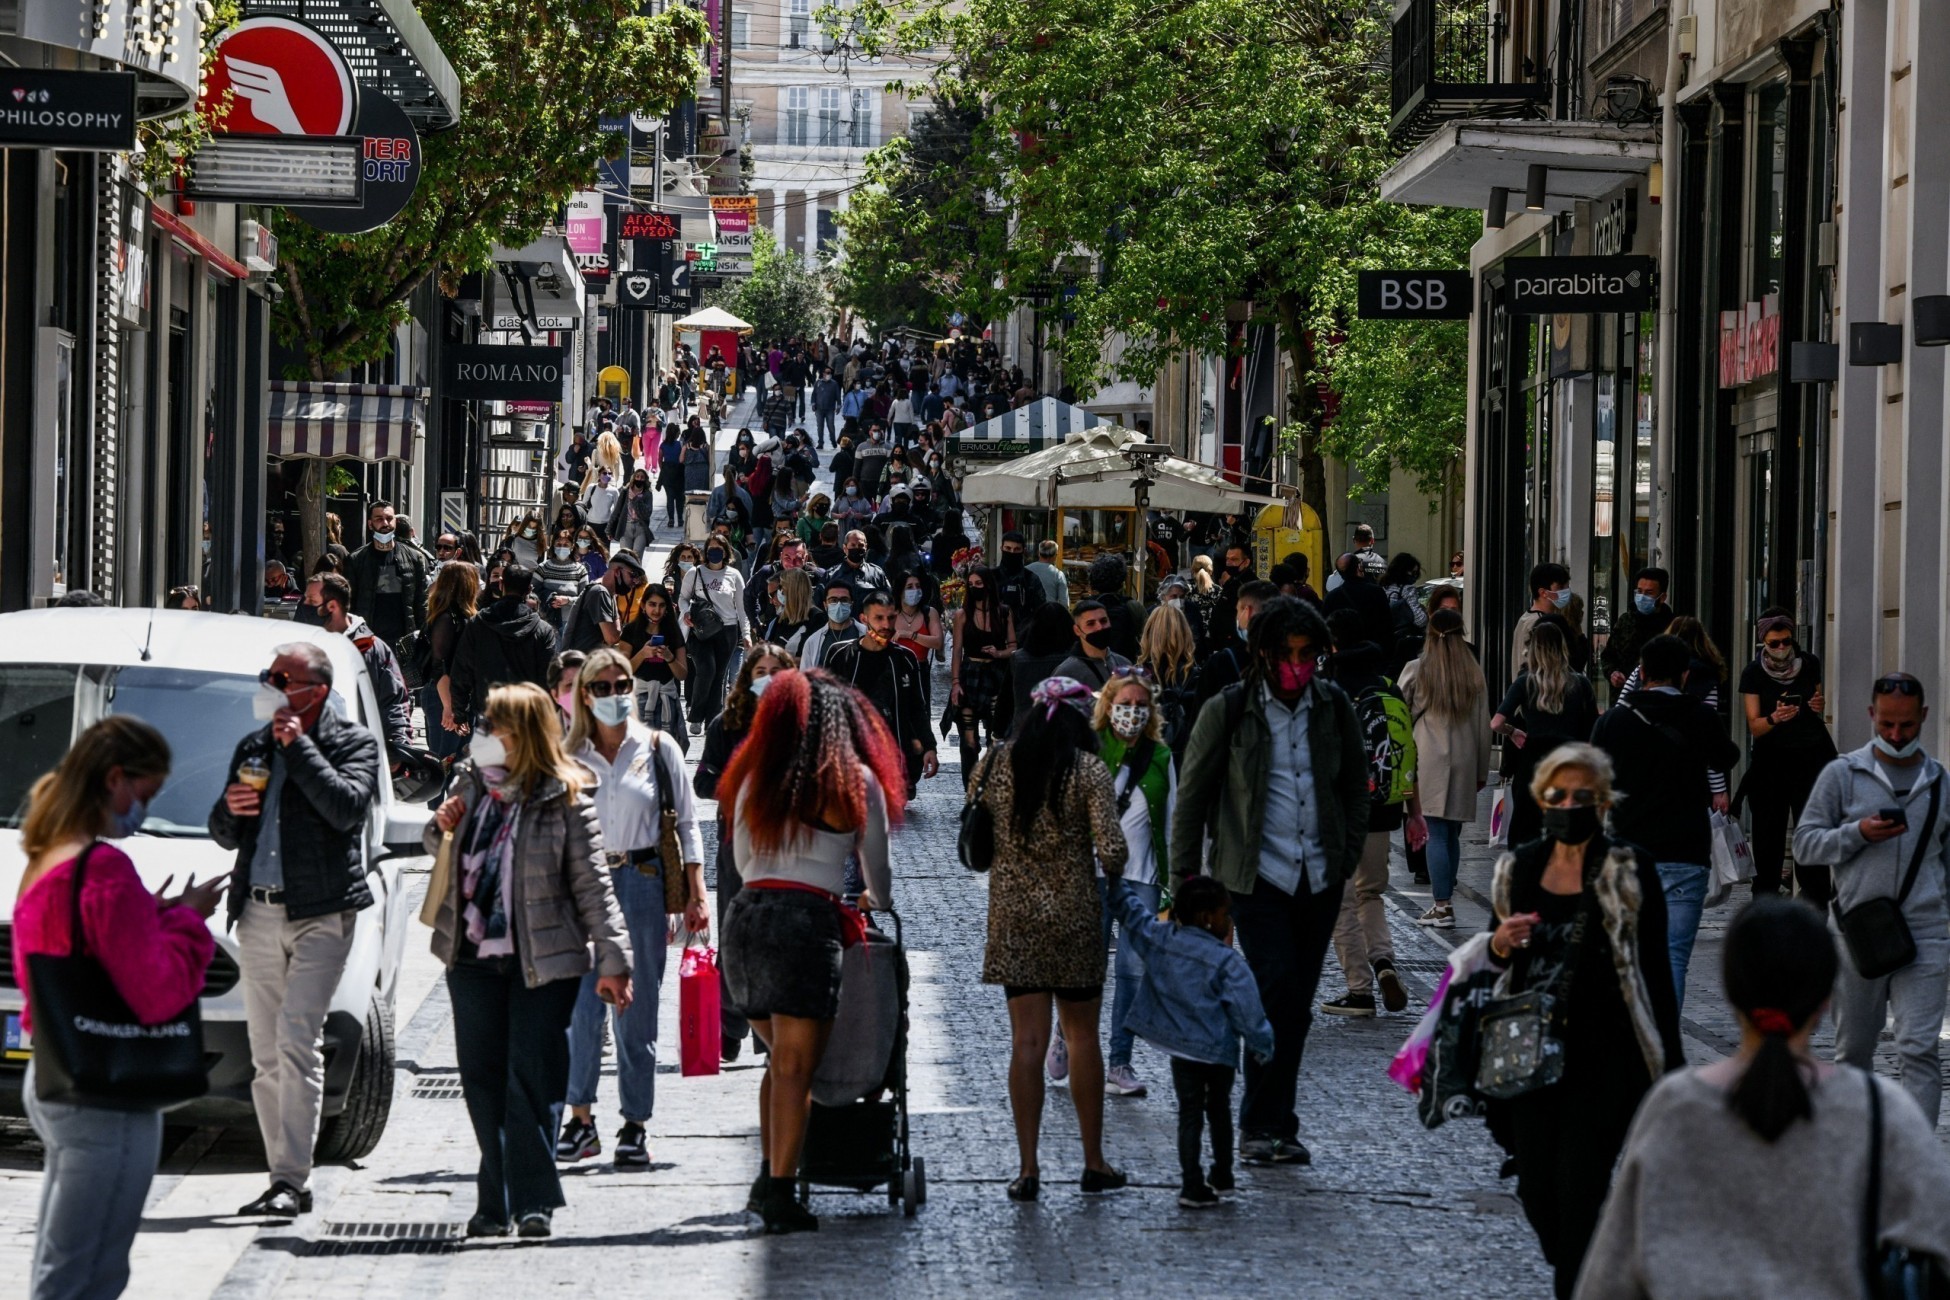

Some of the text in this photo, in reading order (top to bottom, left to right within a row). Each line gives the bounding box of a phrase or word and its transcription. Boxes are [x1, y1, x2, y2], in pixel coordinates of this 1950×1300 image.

[713, 197, 751, 205] ΑΓΟΡΑ
[626, 214, 672, 226] ΑΓΟΡΑ
[622, 226, 675, 238] ΧΡΥΣΟΥ
[1515, 272, 1624, 299] parabita
[1380, 279, 1448, 311] BSB
[457, 363, 558, 383] ROMANO
[959, 443, 996, 451] ERMOU
